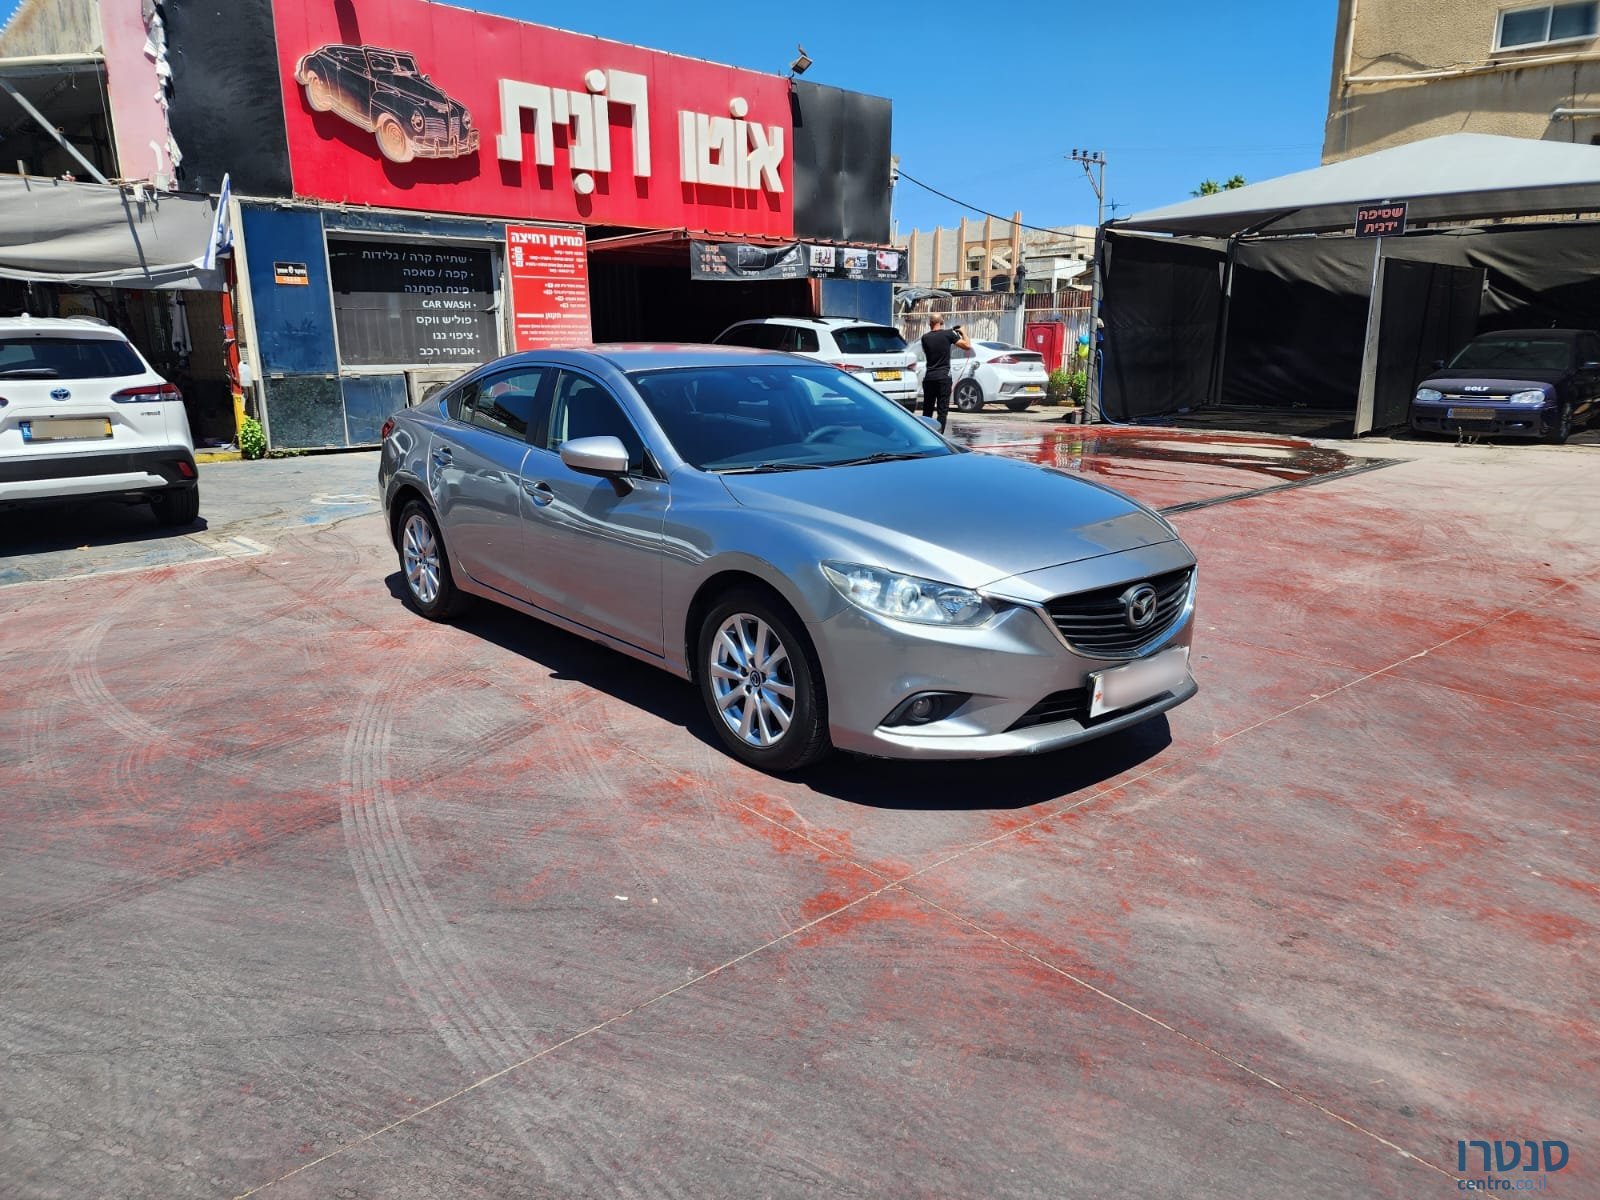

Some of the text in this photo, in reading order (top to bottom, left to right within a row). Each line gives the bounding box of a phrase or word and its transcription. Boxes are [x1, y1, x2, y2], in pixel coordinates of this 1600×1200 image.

[1359, 208, 1403, 220] שטיפה
[1364, 222, 1398, 233] ידנית
[511, 232, 583, 247] מחירון רחיצה
[362, 250, 399, 260] גלידות
[409, 253, 432, 263] קרה
[435, 254, 467, 263] שתייה
[403, 268, 436, 277] מאפה
[445, 270, 468, 280] קפה
[404, 284, 470, 294] פינת המתנה
[422, 300, 471, 309] CAR WASH
[416, 315, 472, 326] פוליש ווקס
[432, 332, 473, 340] ציפוי ננו
[419, 347, 475, 356] אביזרי רכב
